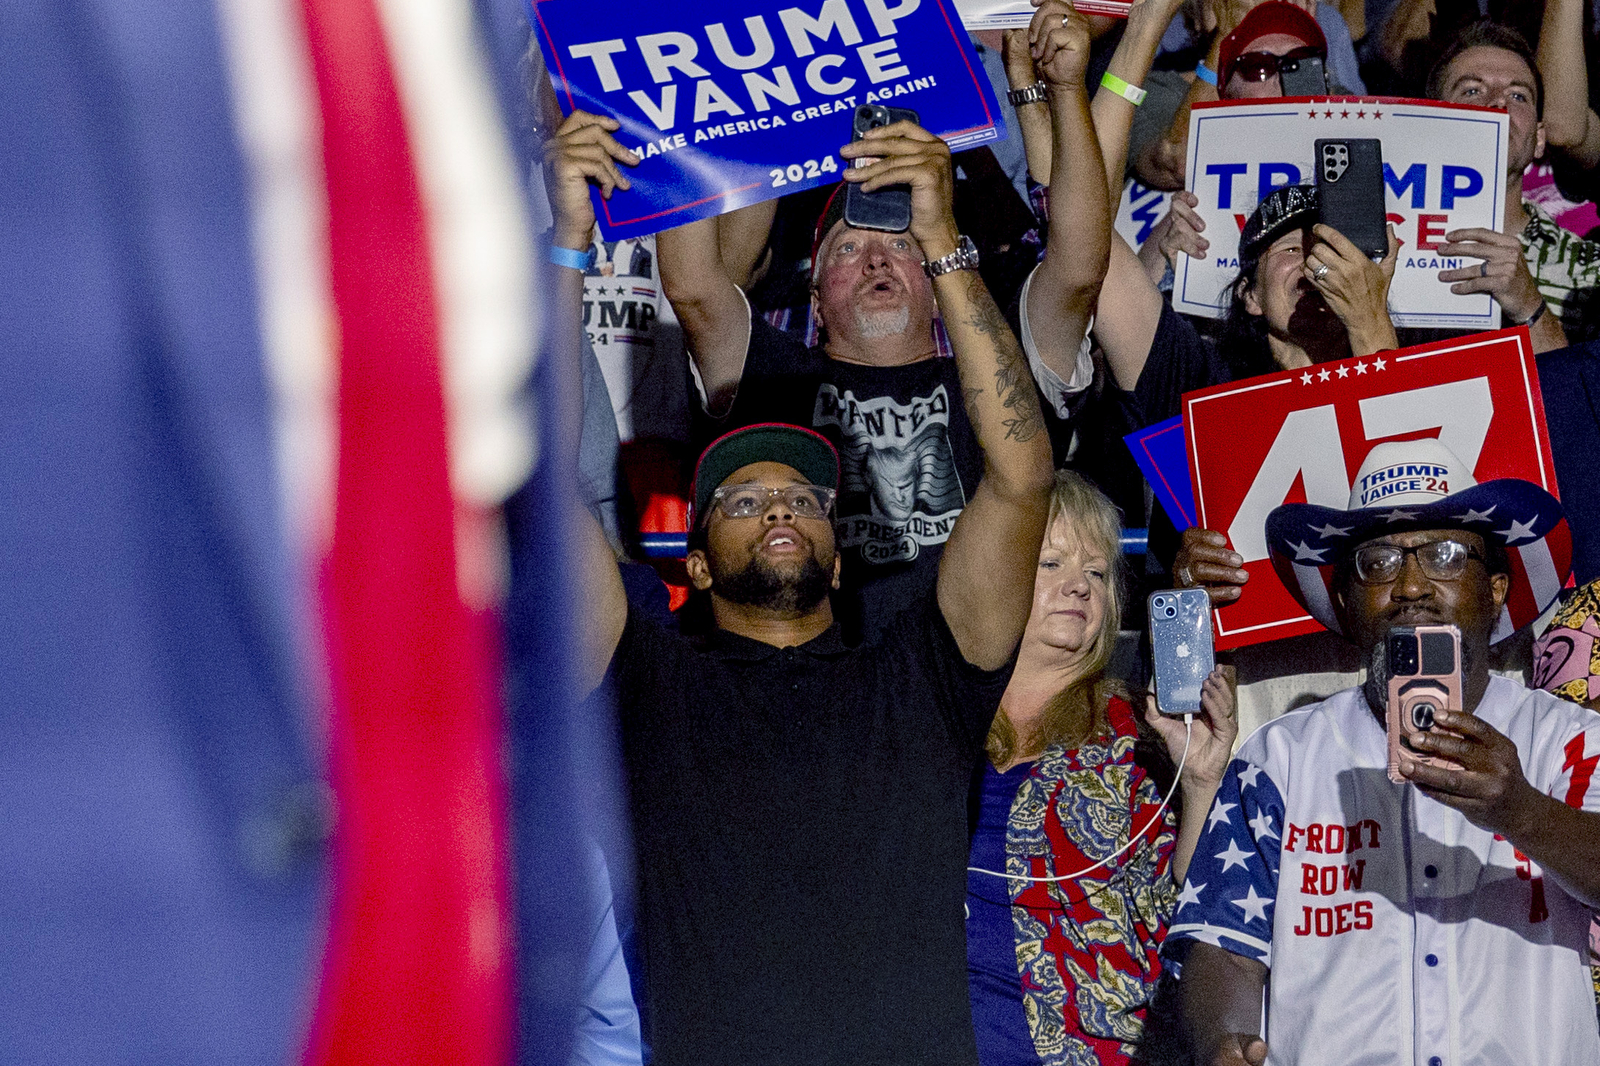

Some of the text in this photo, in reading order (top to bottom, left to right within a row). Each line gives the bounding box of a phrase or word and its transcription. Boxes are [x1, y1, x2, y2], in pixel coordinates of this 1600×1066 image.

[627, 38, 911, 132] VANCE
[630, 76, 938, 162] MAKE AMERICA GREAT AGAIN!
[769, 155, 838, 189] 2024
[1206, 162, 1484, 210] TRMP
[1262, 185, 1319, 228] MA
[1405, 257, 1463, 270] AGAIN!
[583, 300, 655, 332] UMP
[1227, 376, 1494, 563] 47
[1360, 464, 1449, 490] TRUMP
[1360, 476, 1450, 506] VANCE '24
[868, 540, 910, 559] 2024
[1284, 819, 1382, 854] FRONT
[1300, 859, 1366, 896] ROW
[1294, 900, 1373, 937] JOES
